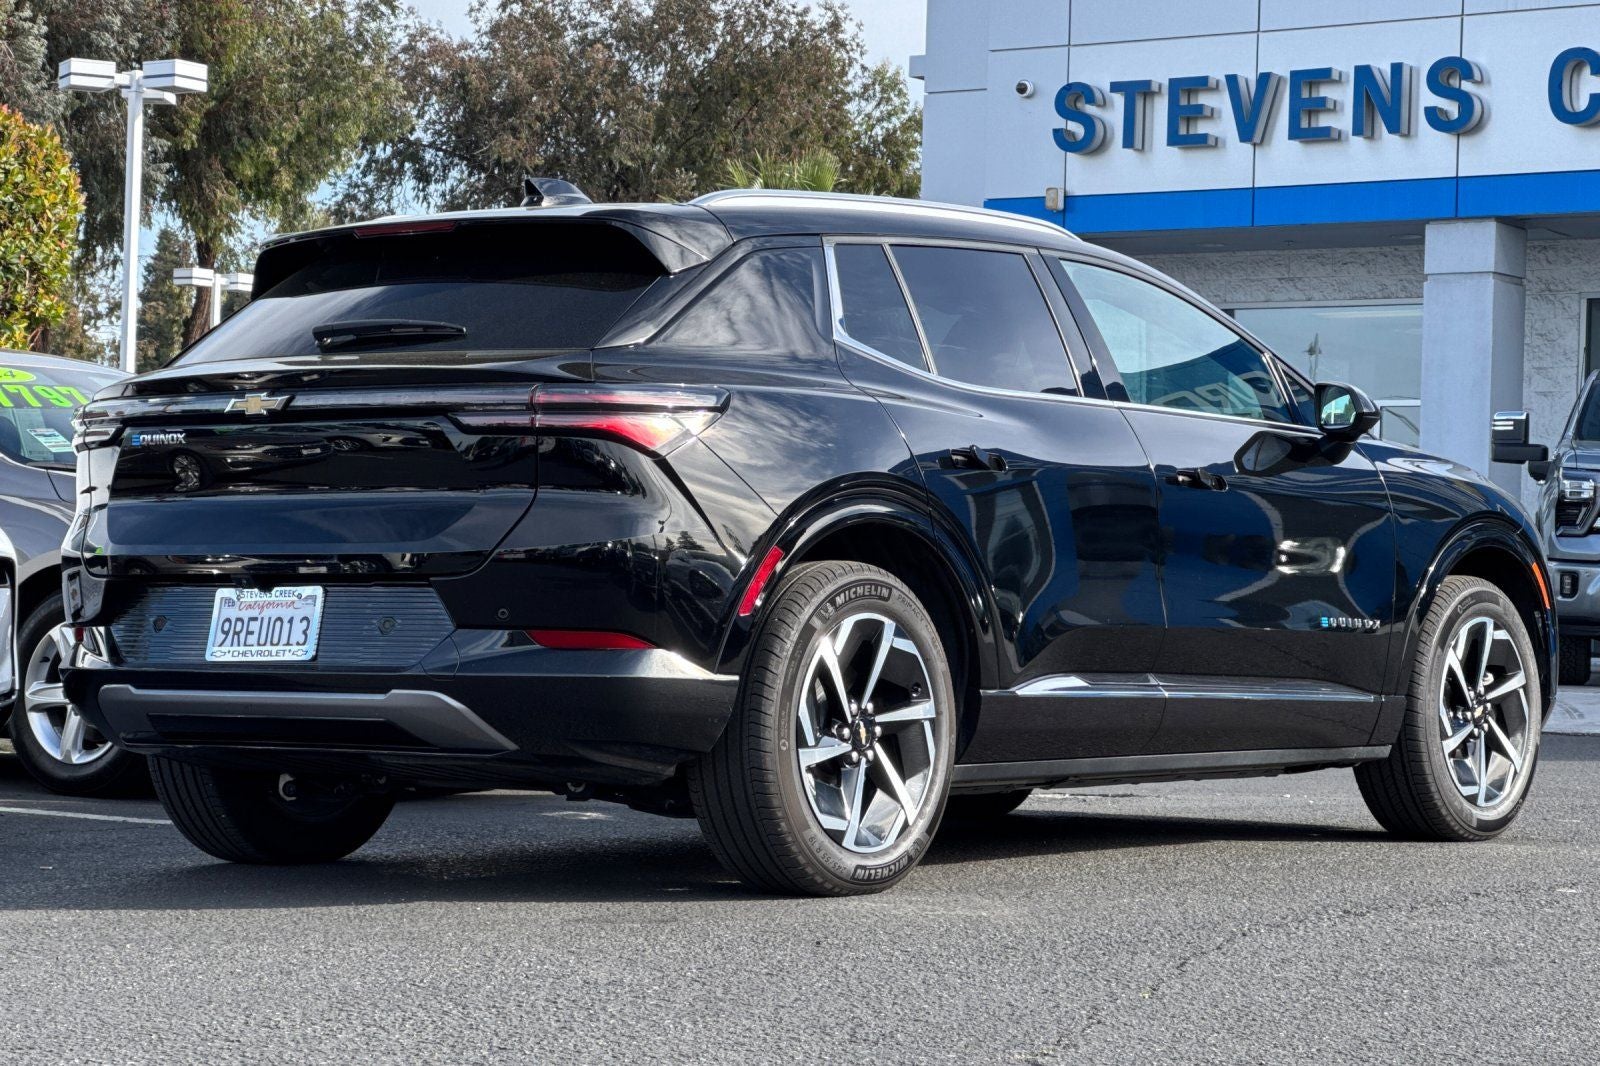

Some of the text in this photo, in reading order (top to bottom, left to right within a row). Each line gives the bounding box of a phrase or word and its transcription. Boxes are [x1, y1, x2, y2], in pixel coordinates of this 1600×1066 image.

[1052, 46, 1600, 155] STEVENS C
[131, 433, 186, 446] EQUINOX
[274, 588, 298, 599] CREEK
[835, 585, 890, 608] MICHELIN
[223, 599, 236, 608] FEB
[238, 600, 301, 615] California
[218, 616, 311, 647] 9REU013
[231, 649, 286, 658] CHEVROLET
[855, 853, 909, 879] MICHELIN
